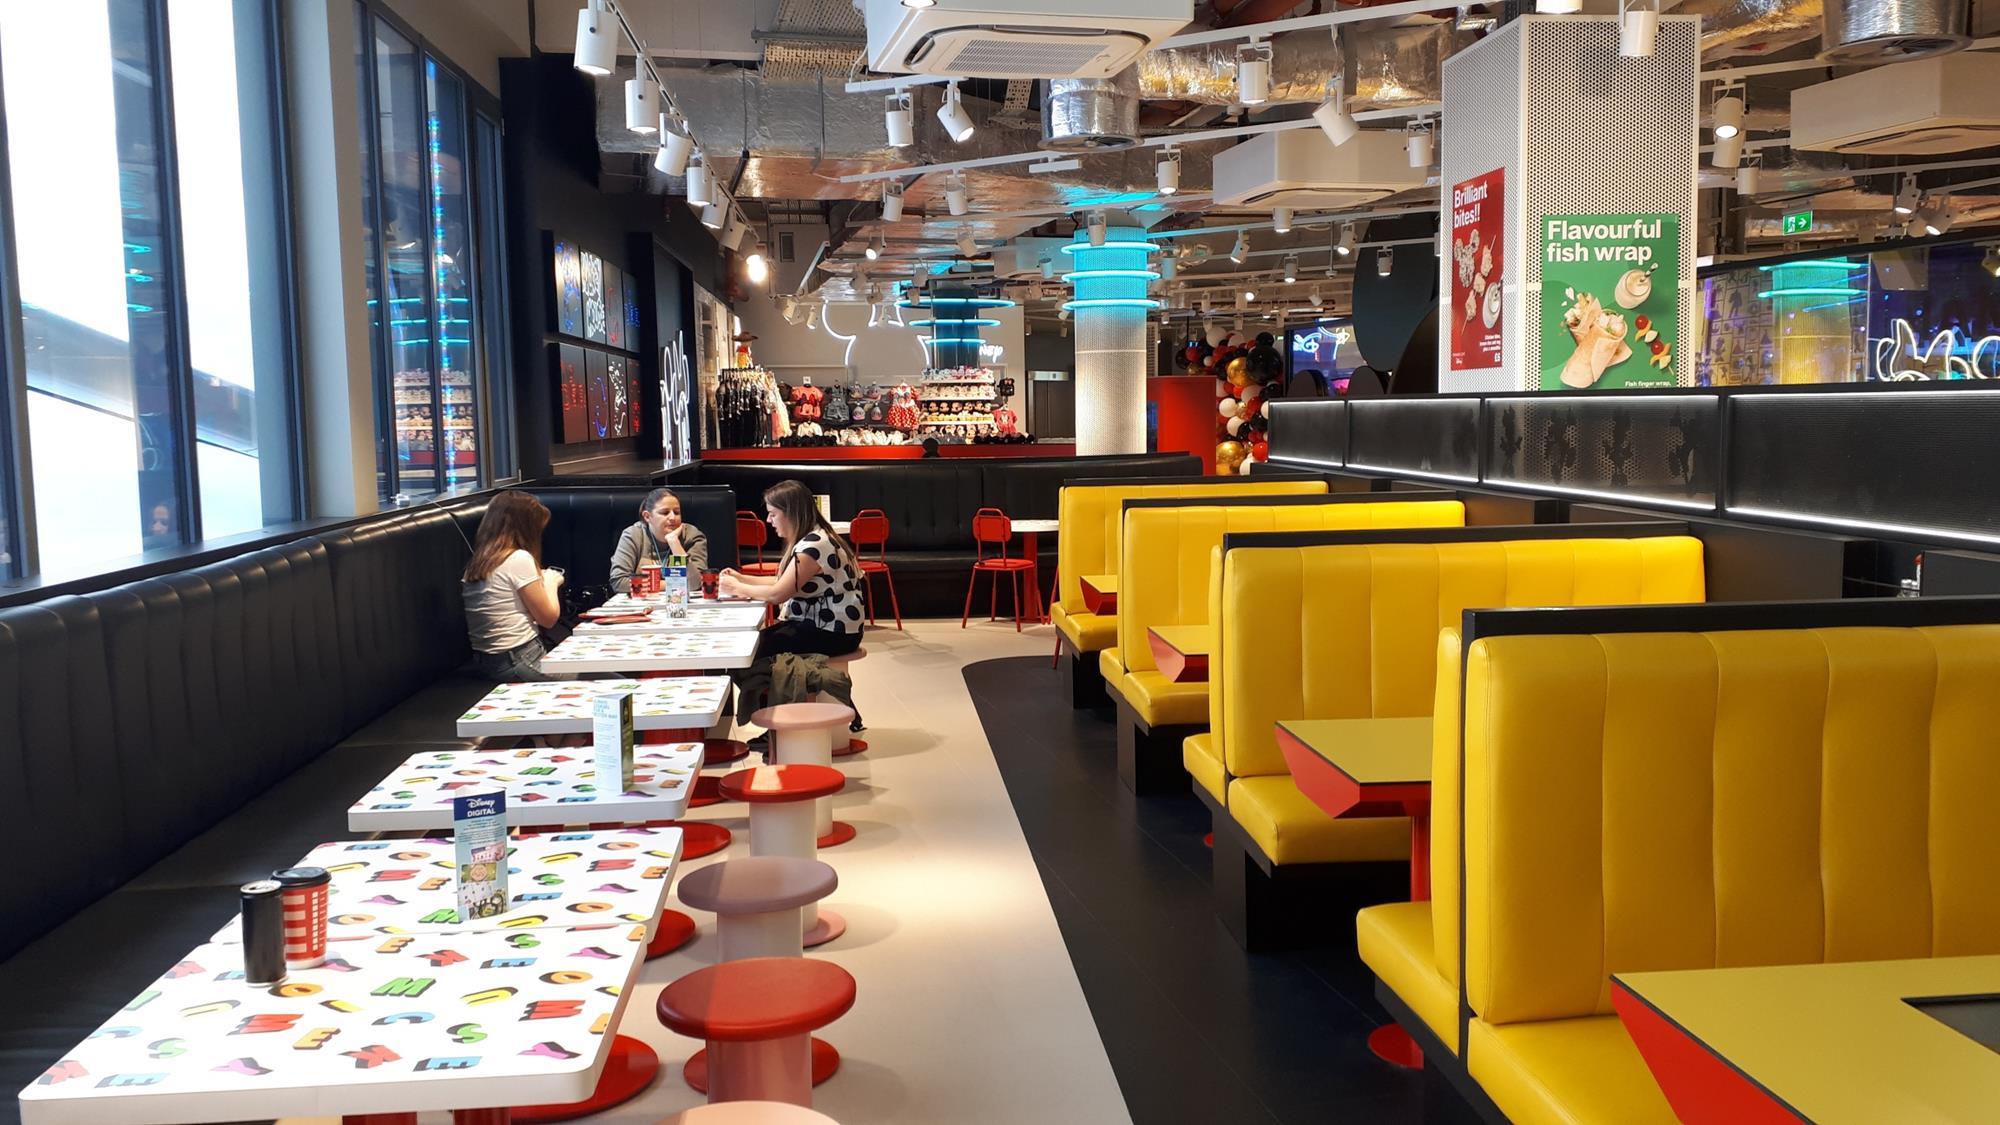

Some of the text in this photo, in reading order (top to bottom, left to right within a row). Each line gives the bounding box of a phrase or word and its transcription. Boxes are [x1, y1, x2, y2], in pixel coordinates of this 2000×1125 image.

[1455, 180, 1487, 208] Brilliant
[1454, 203, 1480, 228] bites!!
[1548, 219, 1661, 240] Flavourful
[1547, 242, 1652, 265] fish wrap
[466, 798, 496, 808] Disney
[467, 809, 496, 817] DIGITAL
